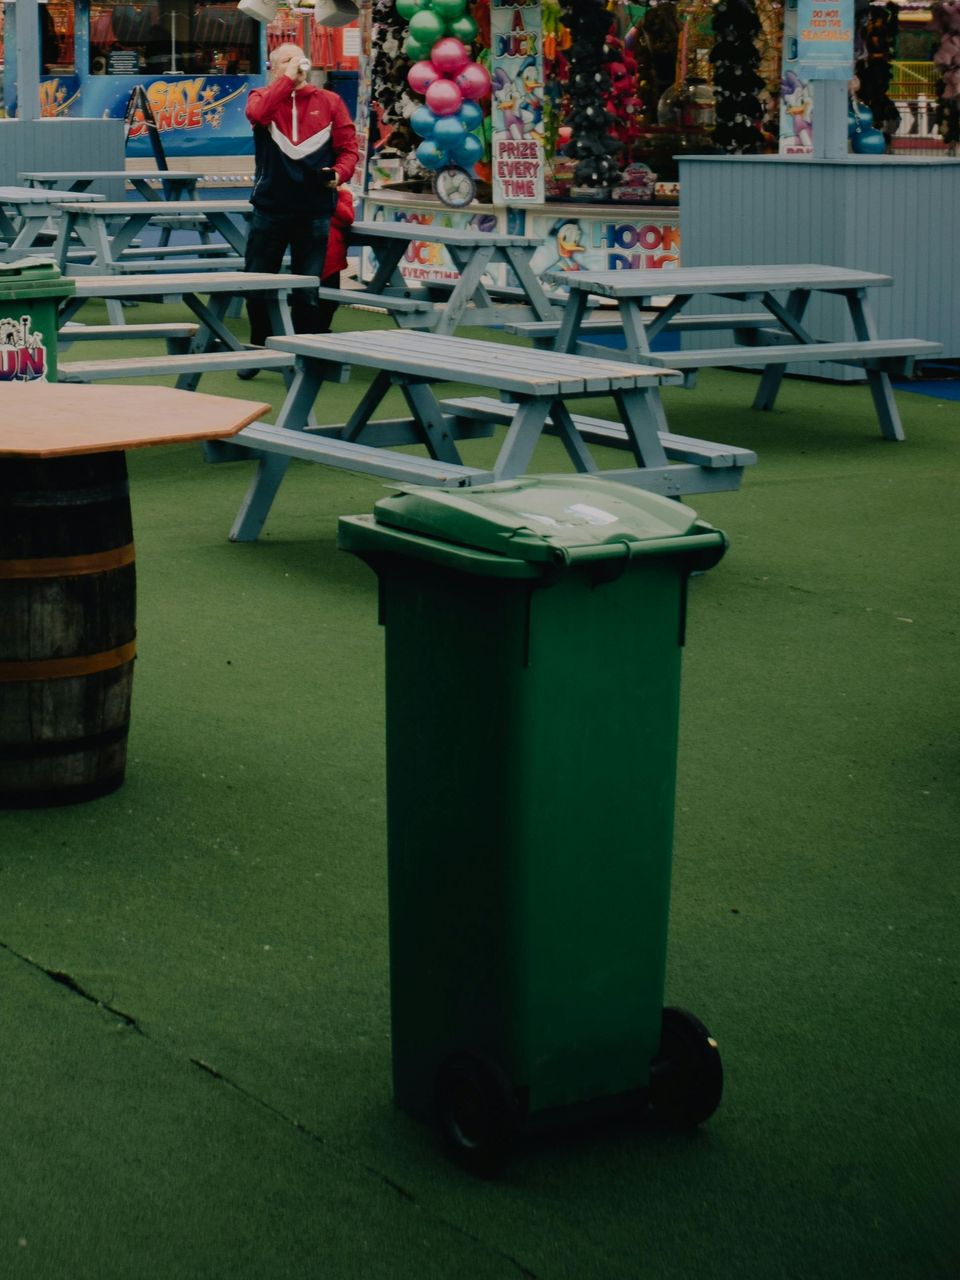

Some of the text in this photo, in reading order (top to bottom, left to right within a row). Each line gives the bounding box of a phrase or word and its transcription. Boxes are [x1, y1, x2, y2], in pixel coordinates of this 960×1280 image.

[512, 9, 525, 31] A
[495, 34, 538, 57] DUCK
[147, 78, 206, 111] SKY
[499, 142, 538, 158] PRIZE
[497, 161, 539, 178] EVERY
[502, 180, 535, 197] TIME
[592, 223, 680, 251] HOOK
